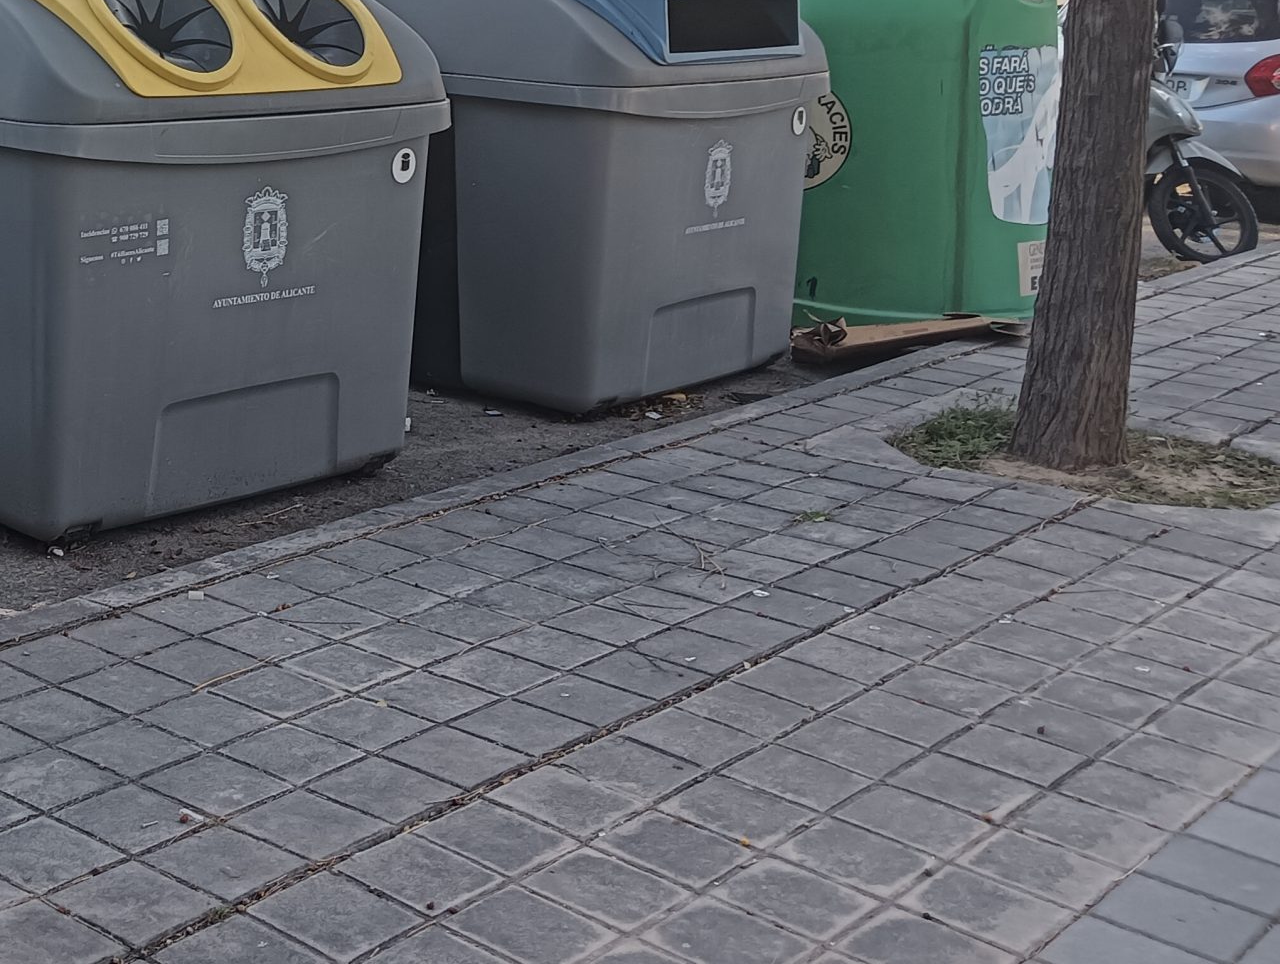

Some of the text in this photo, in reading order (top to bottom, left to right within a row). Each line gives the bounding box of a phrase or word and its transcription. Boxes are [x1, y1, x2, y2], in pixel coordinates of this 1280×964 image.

[212, 285, 316, 309] AYUNTAMIENTO DE ALICANTE
